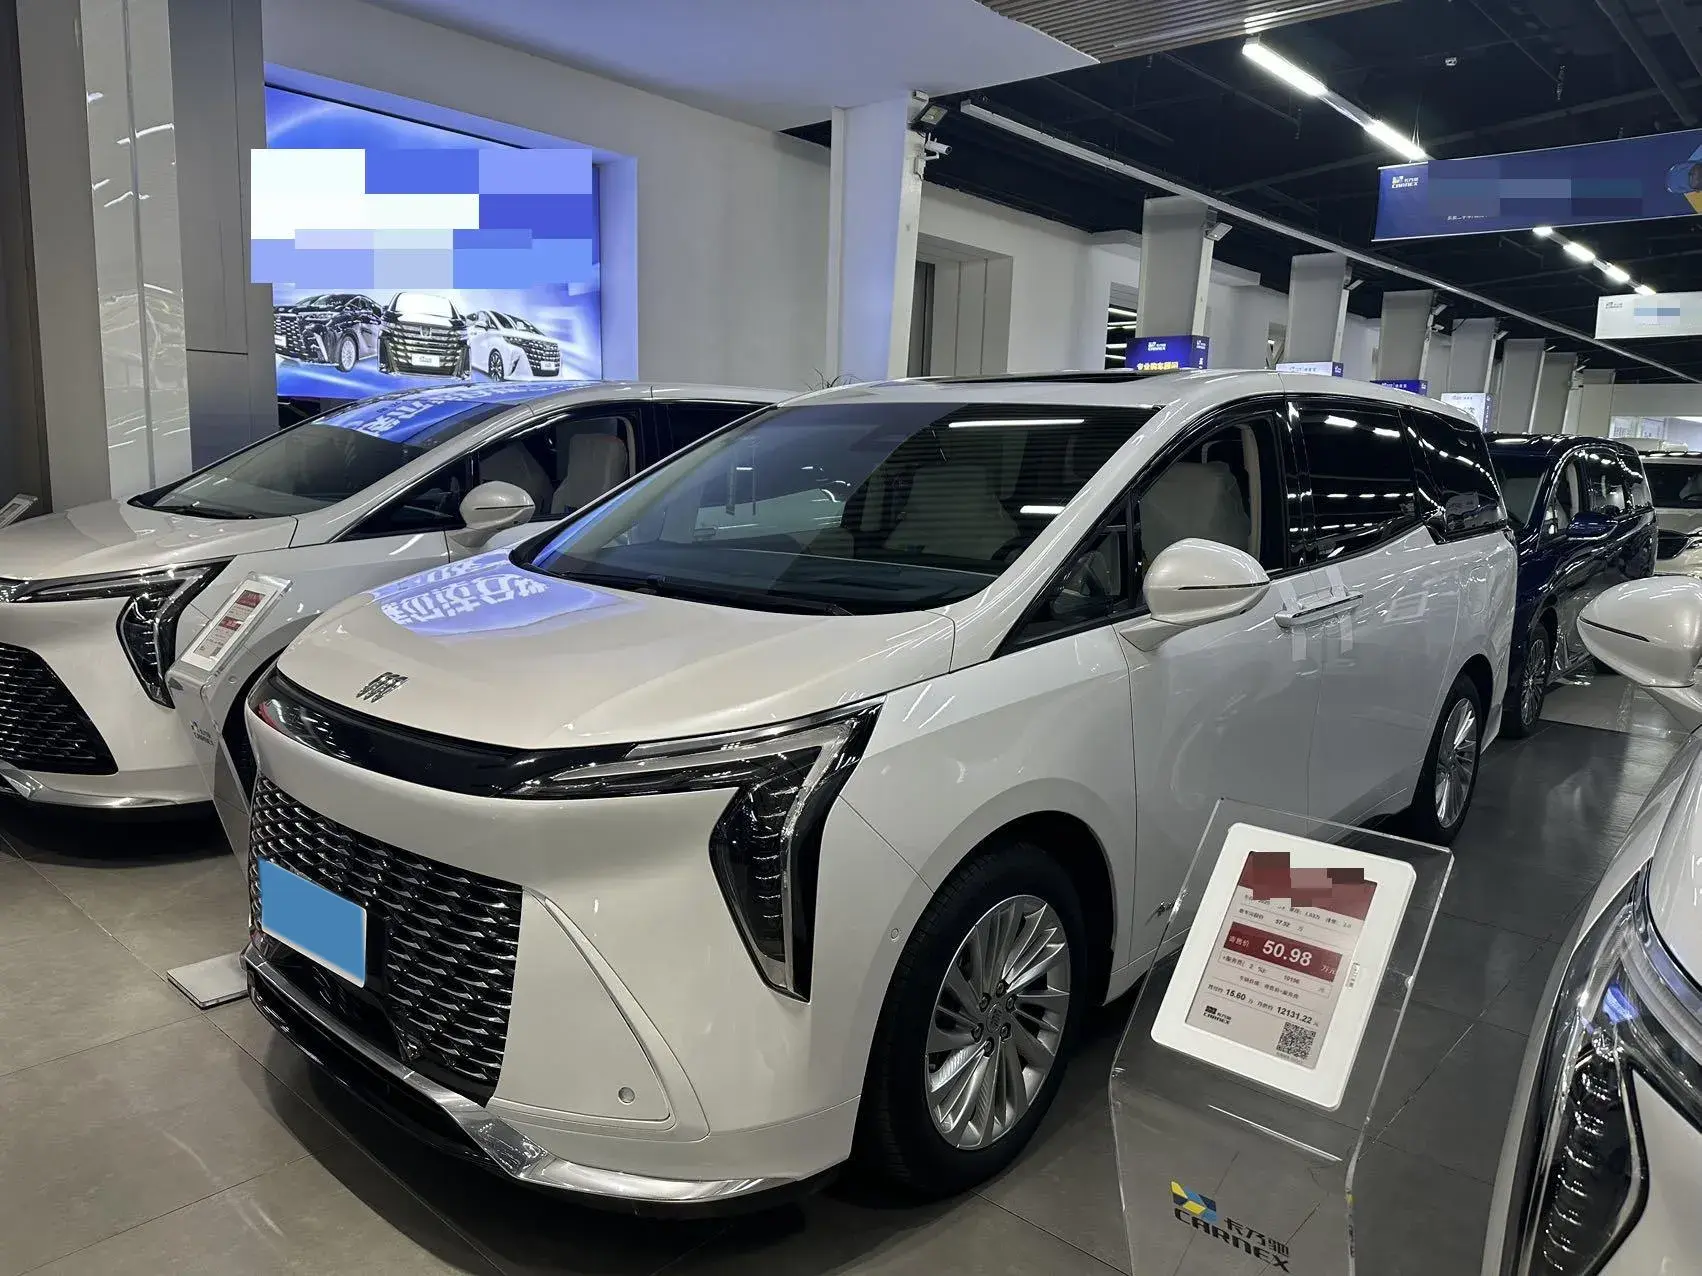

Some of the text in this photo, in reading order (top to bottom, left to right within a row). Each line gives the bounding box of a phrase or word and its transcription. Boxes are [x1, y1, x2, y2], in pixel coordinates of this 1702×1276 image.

[1261, 940, 1313, 967] 50.98
[1225, 988, 1247, 1001] 15.60
[1276, 1006, 1312, 1024] 12131.22
[1173, 1207, 1290, 1273] CARNEX
